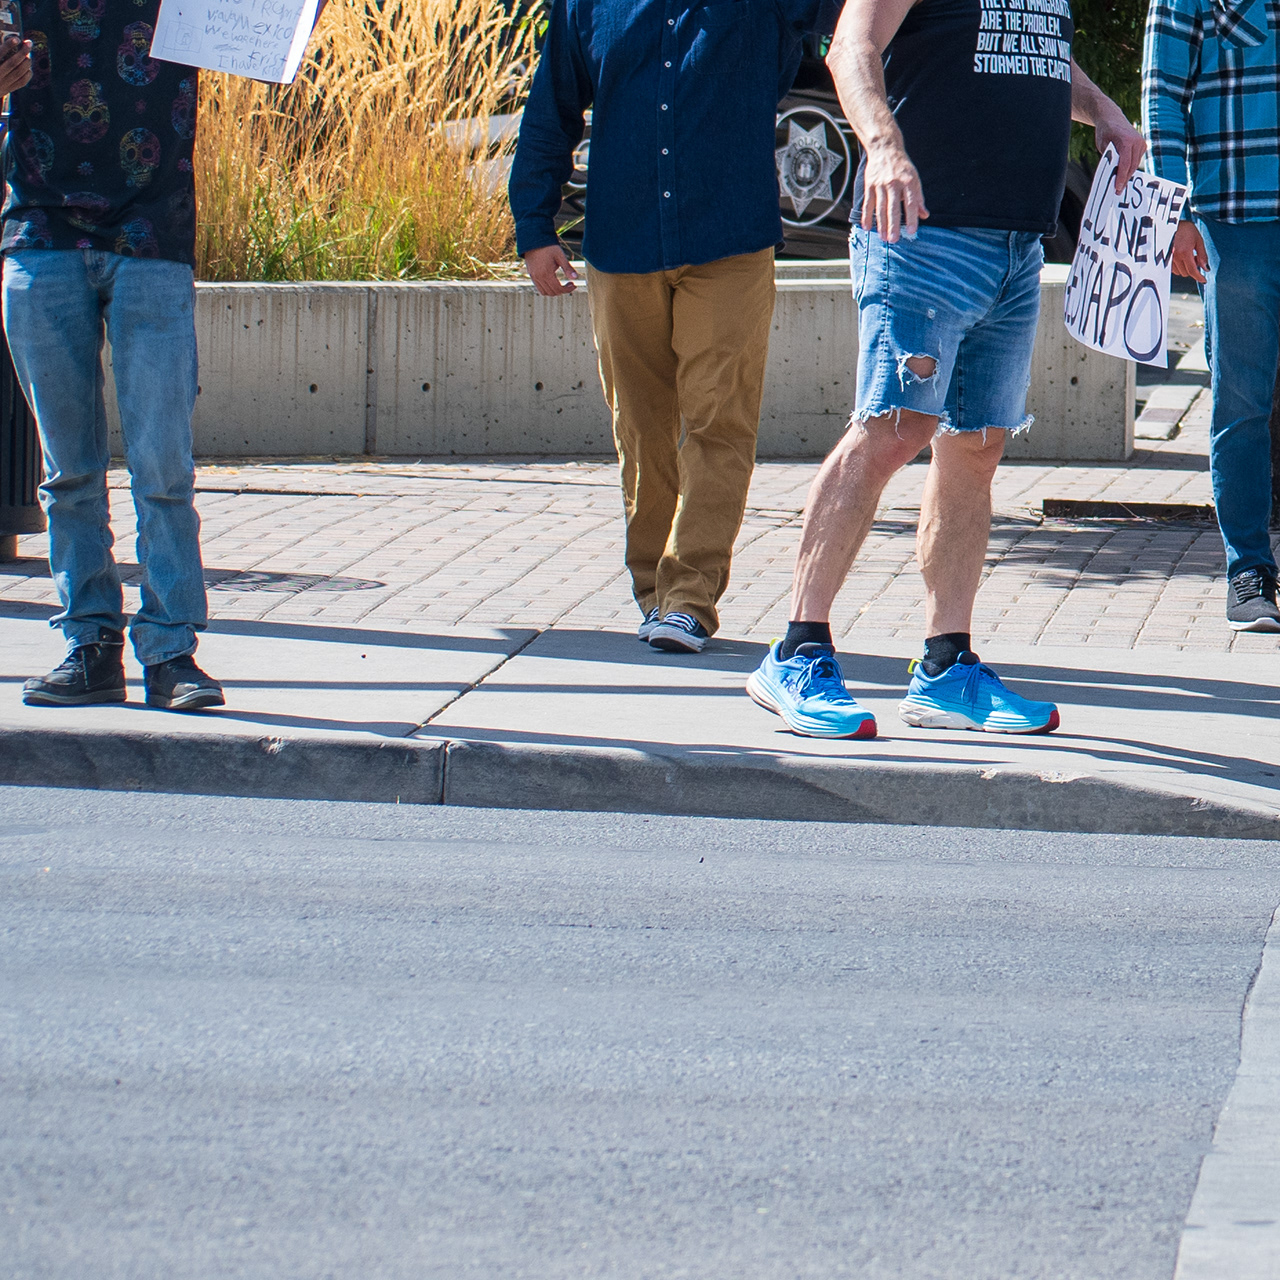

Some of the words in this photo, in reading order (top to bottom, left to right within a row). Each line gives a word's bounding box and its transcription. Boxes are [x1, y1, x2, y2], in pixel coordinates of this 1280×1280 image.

[978, 10, 1002, 30] ARE
[1003, 11, 1021, 32] THE
[976, 32, 1001, 52] BUT
[1002, 33, 1019, 53] WE
[1020, 35, 1039, 54] ALL
[1037, 36, 1058, 57] SAW
[973, 53, 1029, 75] STORMED
[1029, 56, 1048, 77] THE
[1146, 180, 1187, 225] THE
[1114, 211, 1178, 269] NEW
